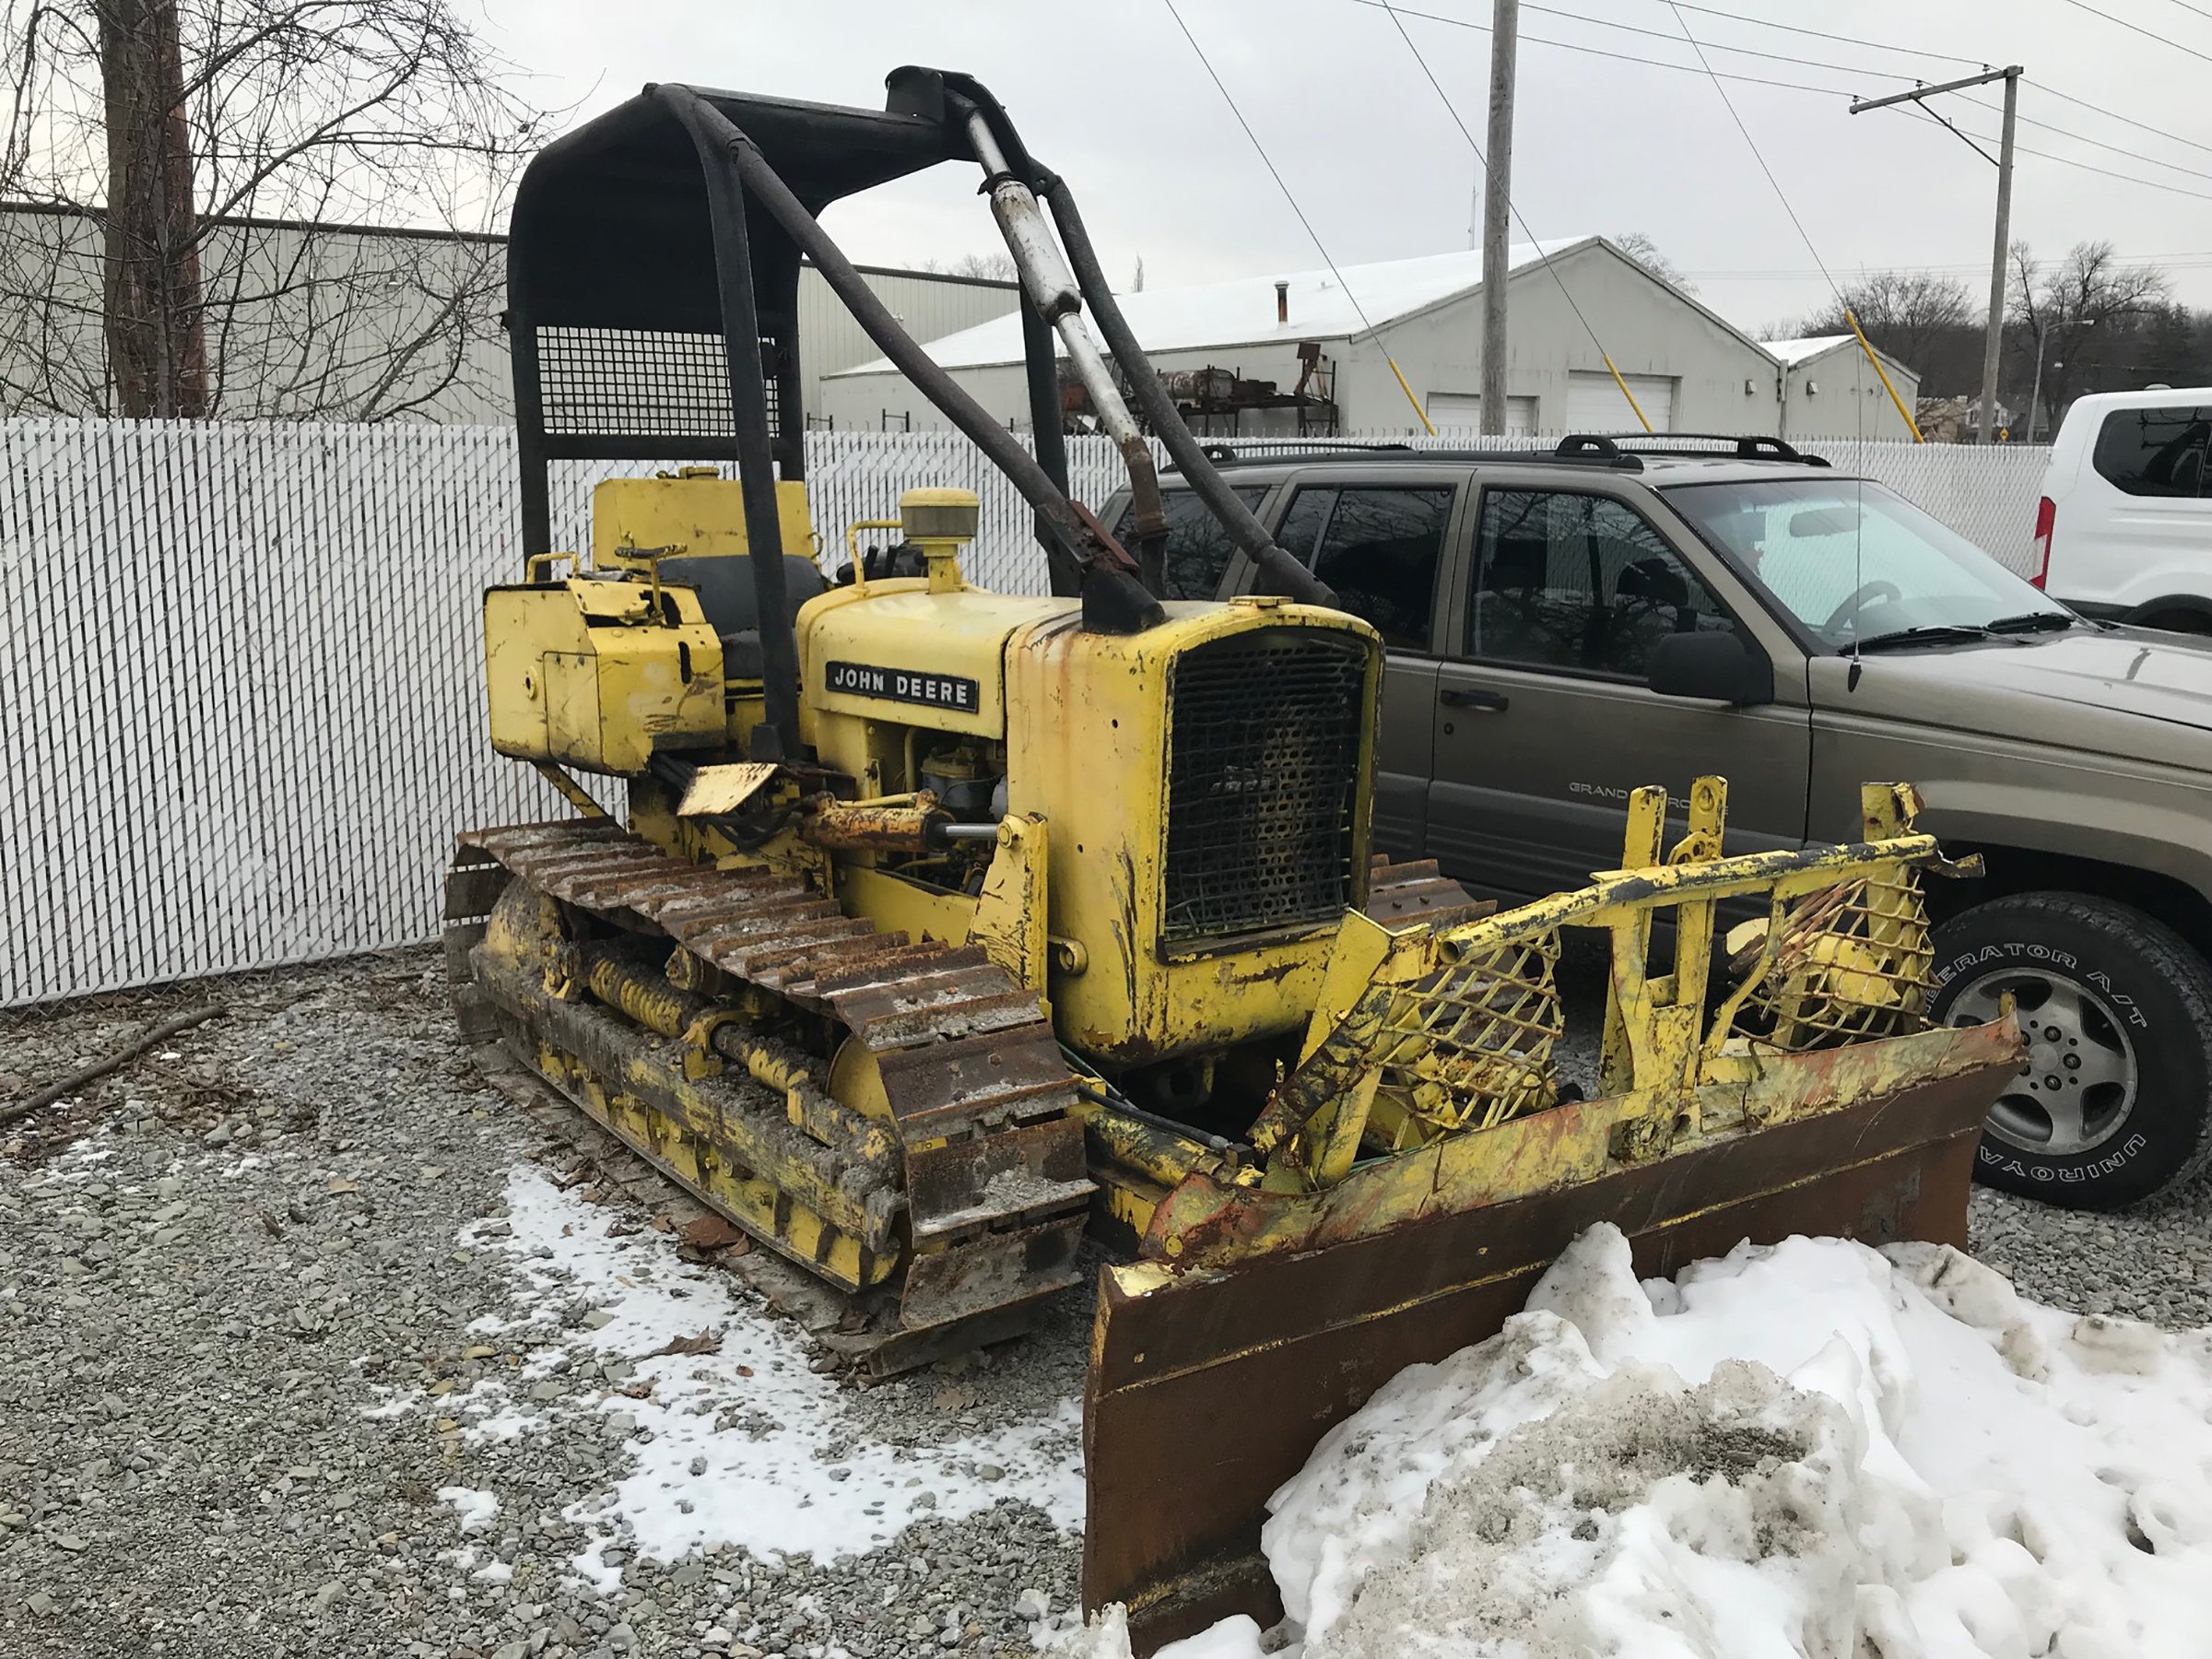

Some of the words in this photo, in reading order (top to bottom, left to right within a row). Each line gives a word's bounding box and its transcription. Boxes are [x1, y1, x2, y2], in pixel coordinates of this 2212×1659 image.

[834, 667, 885, 692] JOHN
[896, 676, 968, 704] DEERE
[1569, 782, 1629, 800] GRAND
[1980, 1133, 2147, 1182] UNIROYA
